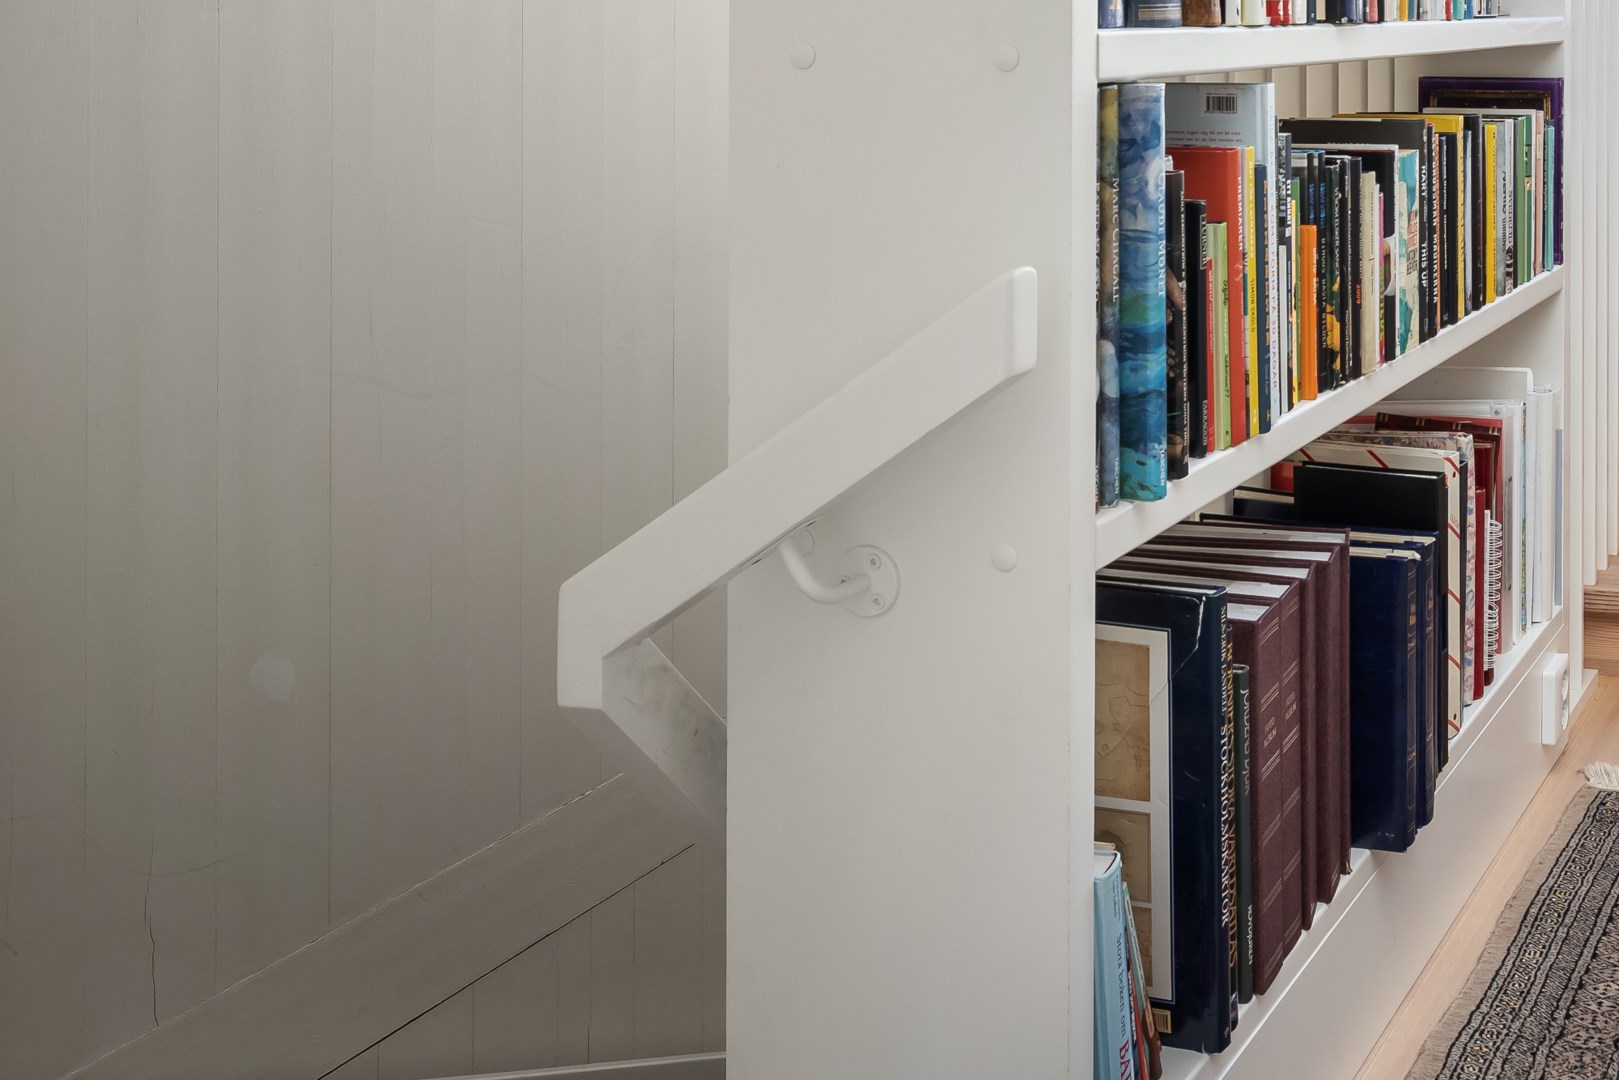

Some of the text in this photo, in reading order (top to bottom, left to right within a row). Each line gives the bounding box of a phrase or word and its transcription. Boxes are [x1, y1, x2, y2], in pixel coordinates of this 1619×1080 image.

[1112, 176, 1120, 304] MARC CHAGALL
[1158, 172, 1166, 298] CLAUDE MONET
[1270, 251, 1278, 291] FORM
[1221, 723, 1230, 929] STOCKHOLMSKARTOR
[1116, 932, 1124, 970] Stora
[1117, 972, 1127, 1012] boken
